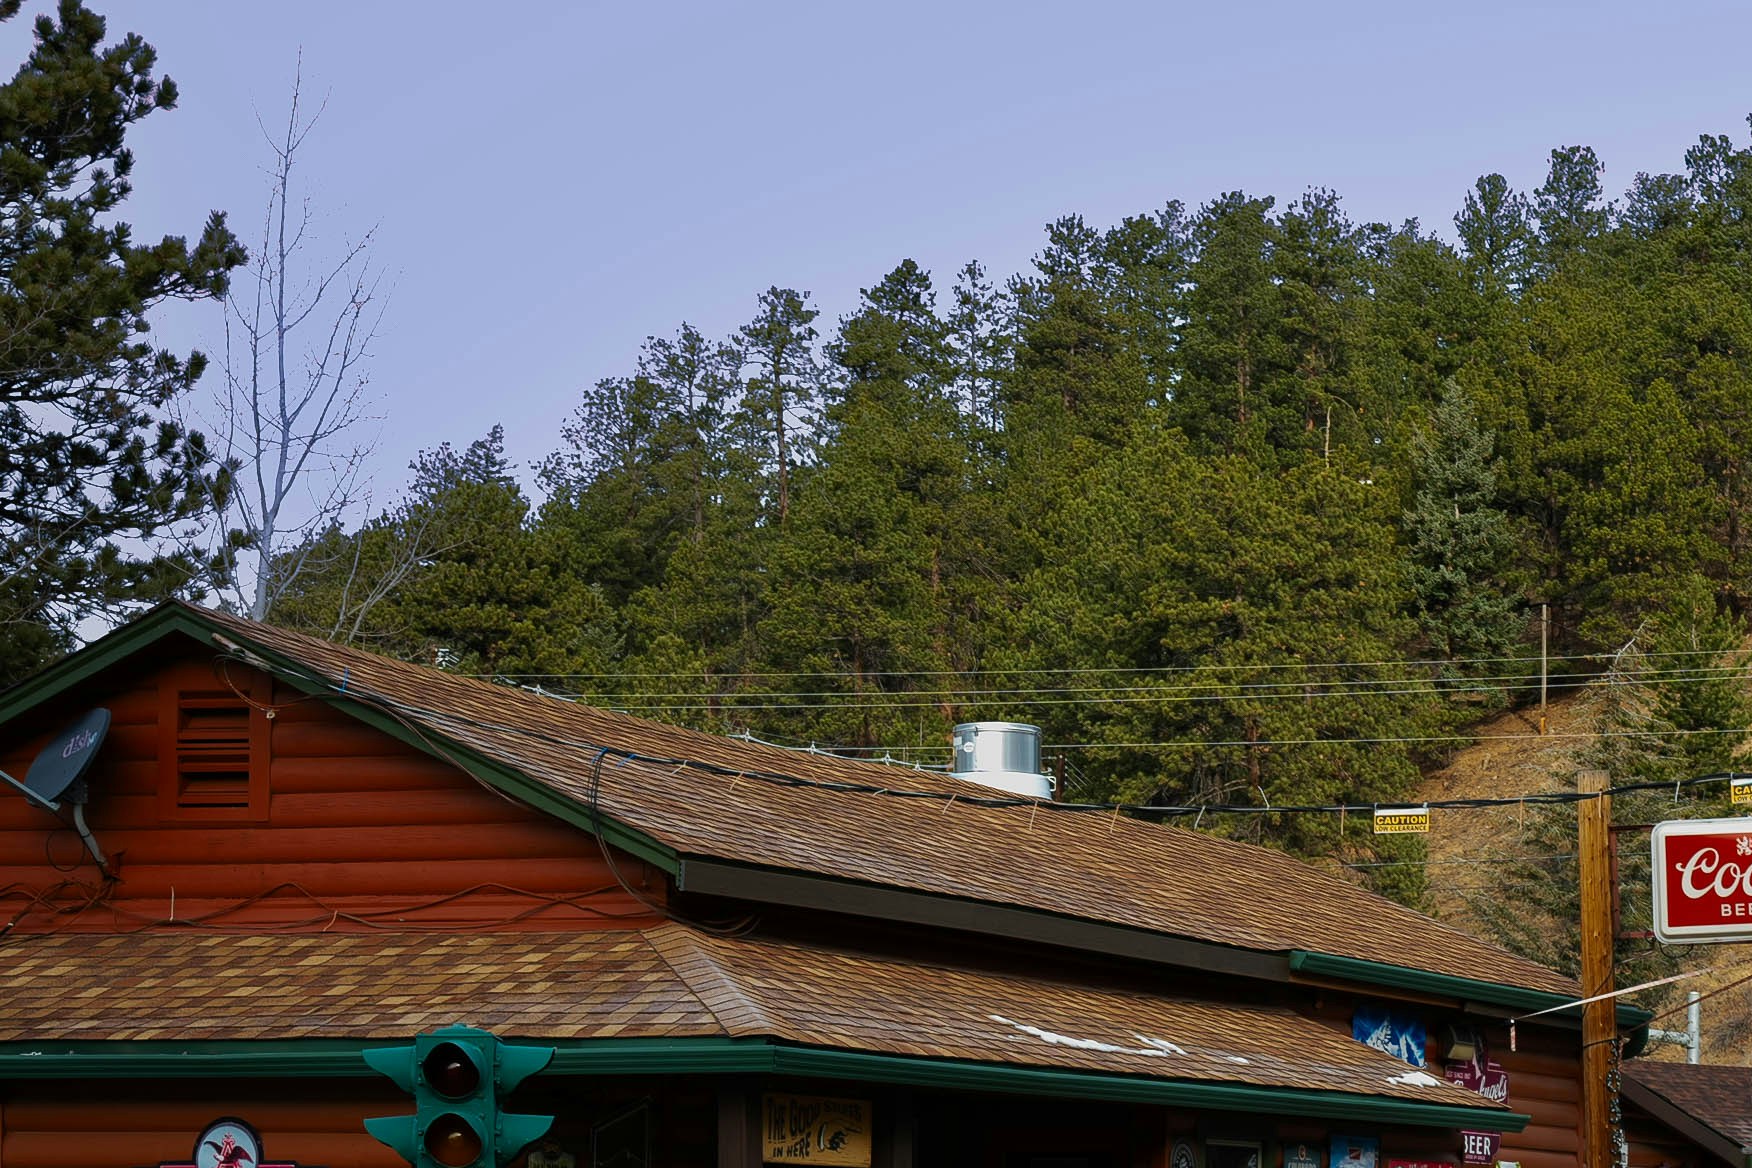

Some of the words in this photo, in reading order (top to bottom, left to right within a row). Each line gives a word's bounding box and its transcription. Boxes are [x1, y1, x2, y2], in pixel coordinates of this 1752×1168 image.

[1376, 815, 1426, 825] CAUTION
[772, 1146, 784, 1158] IN
[786, 1131, 812, 1158] HERE
